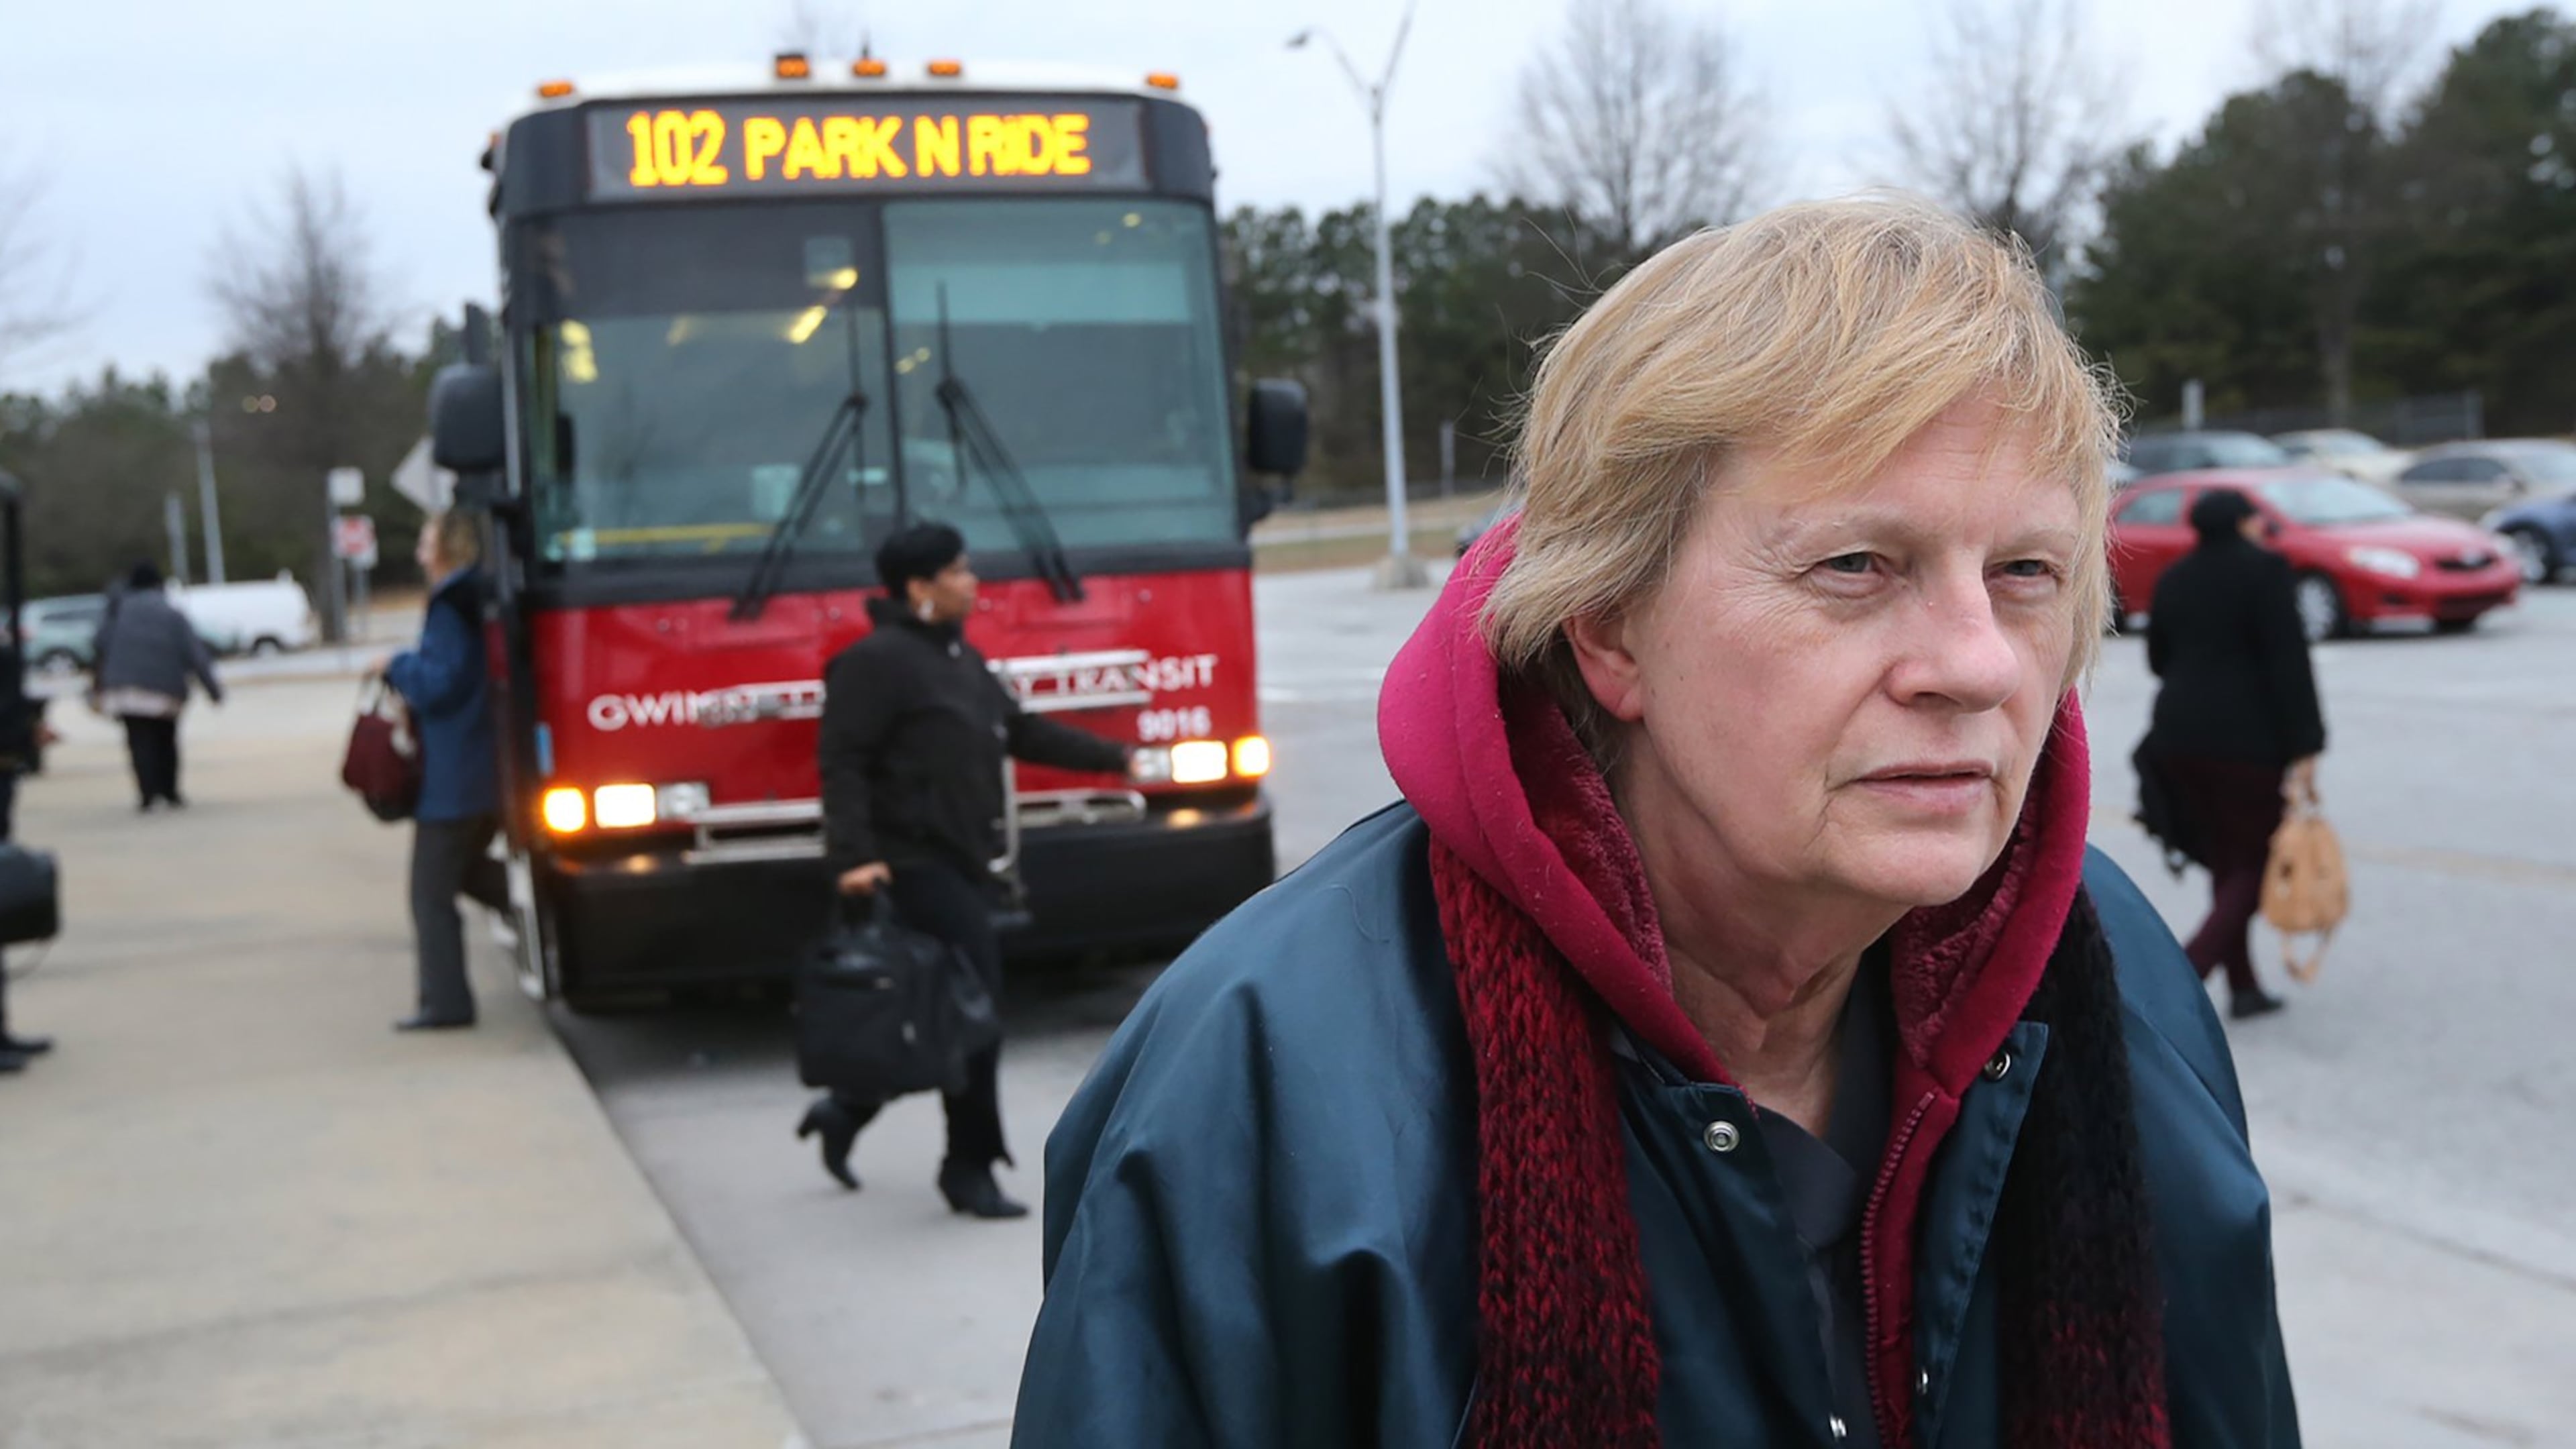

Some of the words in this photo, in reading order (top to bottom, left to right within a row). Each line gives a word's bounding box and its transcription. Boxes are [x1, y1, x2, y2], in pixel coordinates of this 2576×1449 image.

[627, 109, 728, 186] 102
[743, 115, 908, 180] PARK
[914, 115, 960, 177] N
[967, 114, 1091, 176] RIDE
